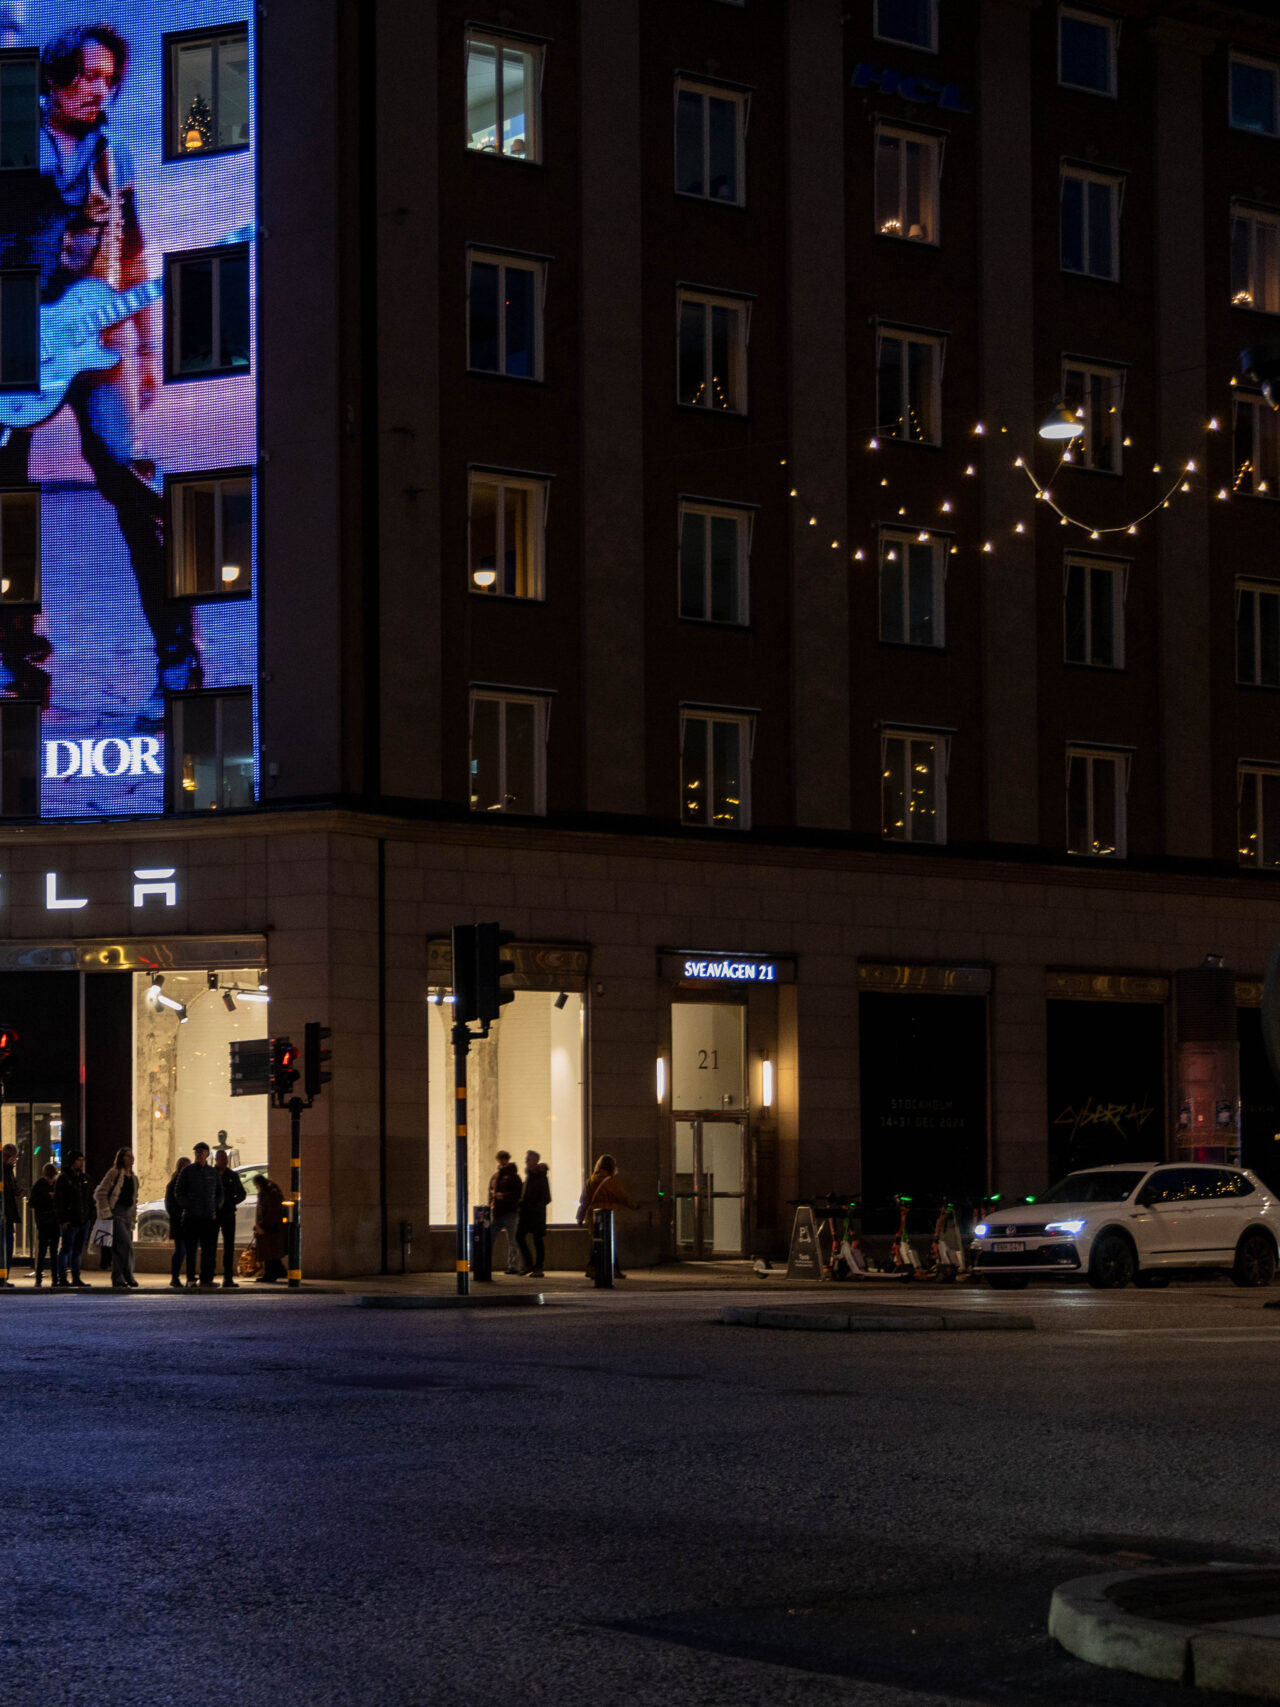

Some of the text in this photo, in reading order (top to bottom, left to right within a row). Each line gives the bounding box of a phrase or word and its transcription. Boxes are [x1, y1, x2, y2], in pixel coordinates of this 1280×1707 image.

[850, 62, 976, 114] HCL
[43, 736, 164, 779] DIOR
[684, 959, 775, 980] SVEAVÄGEN 21
[698, 1050, 720, 1070] 21
